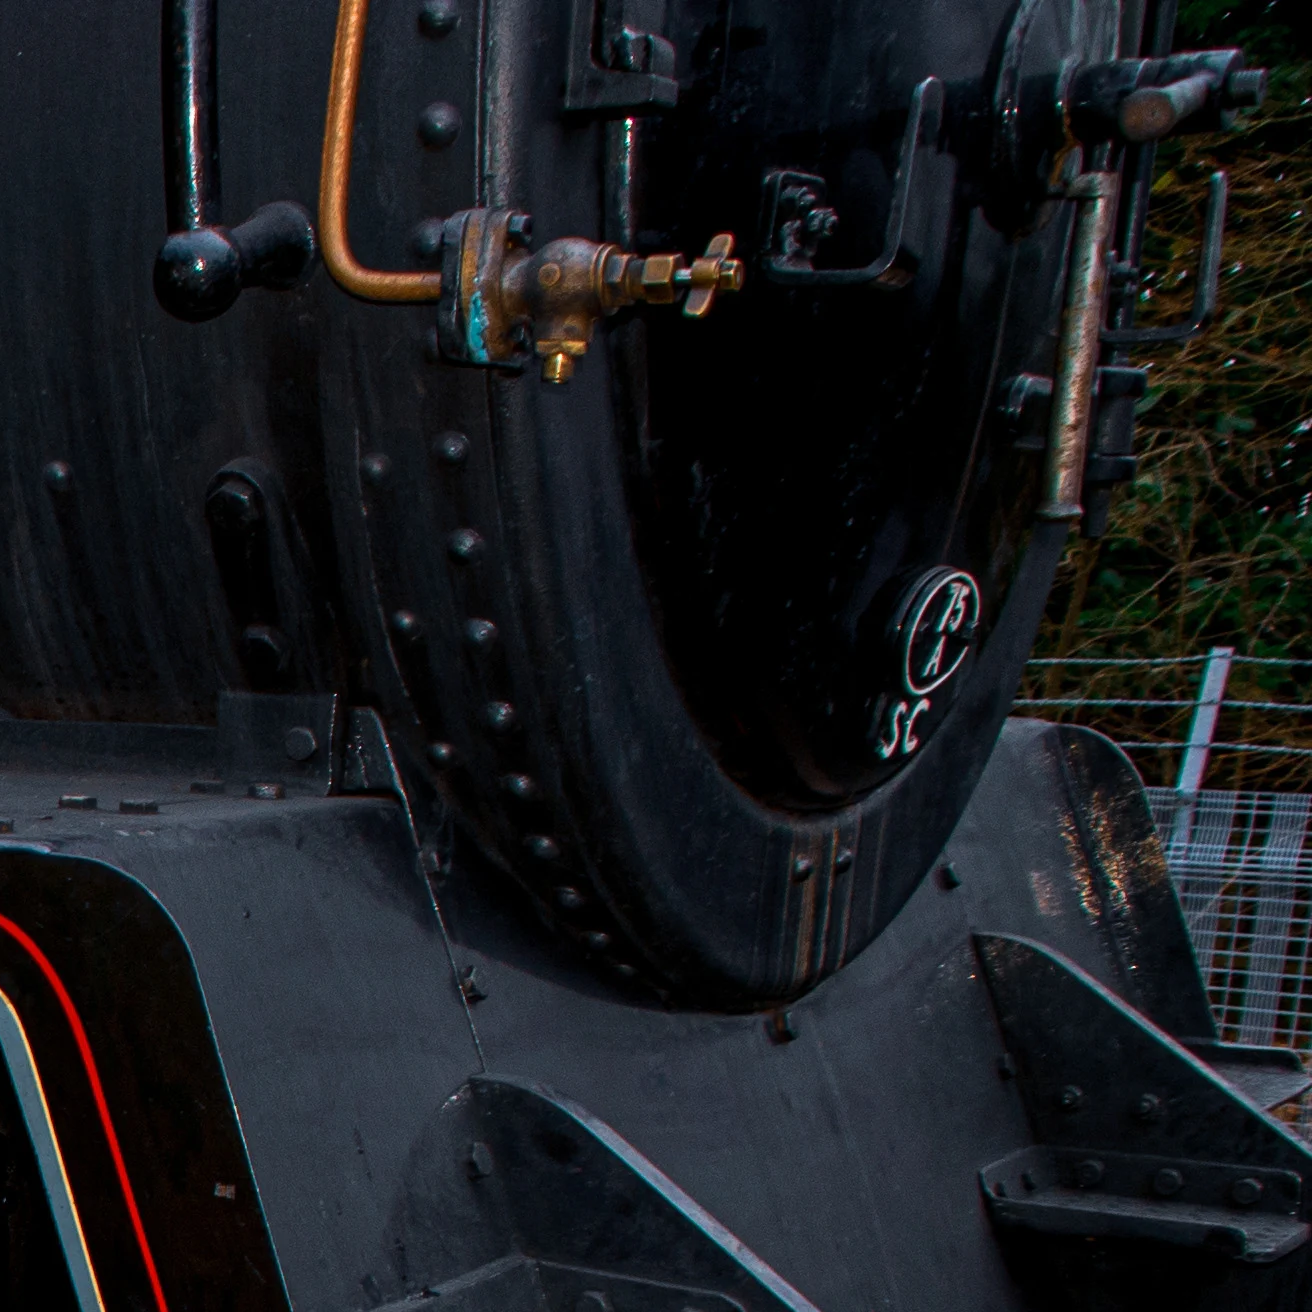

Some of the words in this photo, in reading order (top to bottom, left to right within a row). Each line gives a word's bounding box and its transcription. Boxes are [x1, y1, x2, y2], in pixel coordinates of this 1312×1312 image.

[936, 582, 971, 632] 75
[921, 634, 948, 677] A
[877, 698, 932, 760] SC
